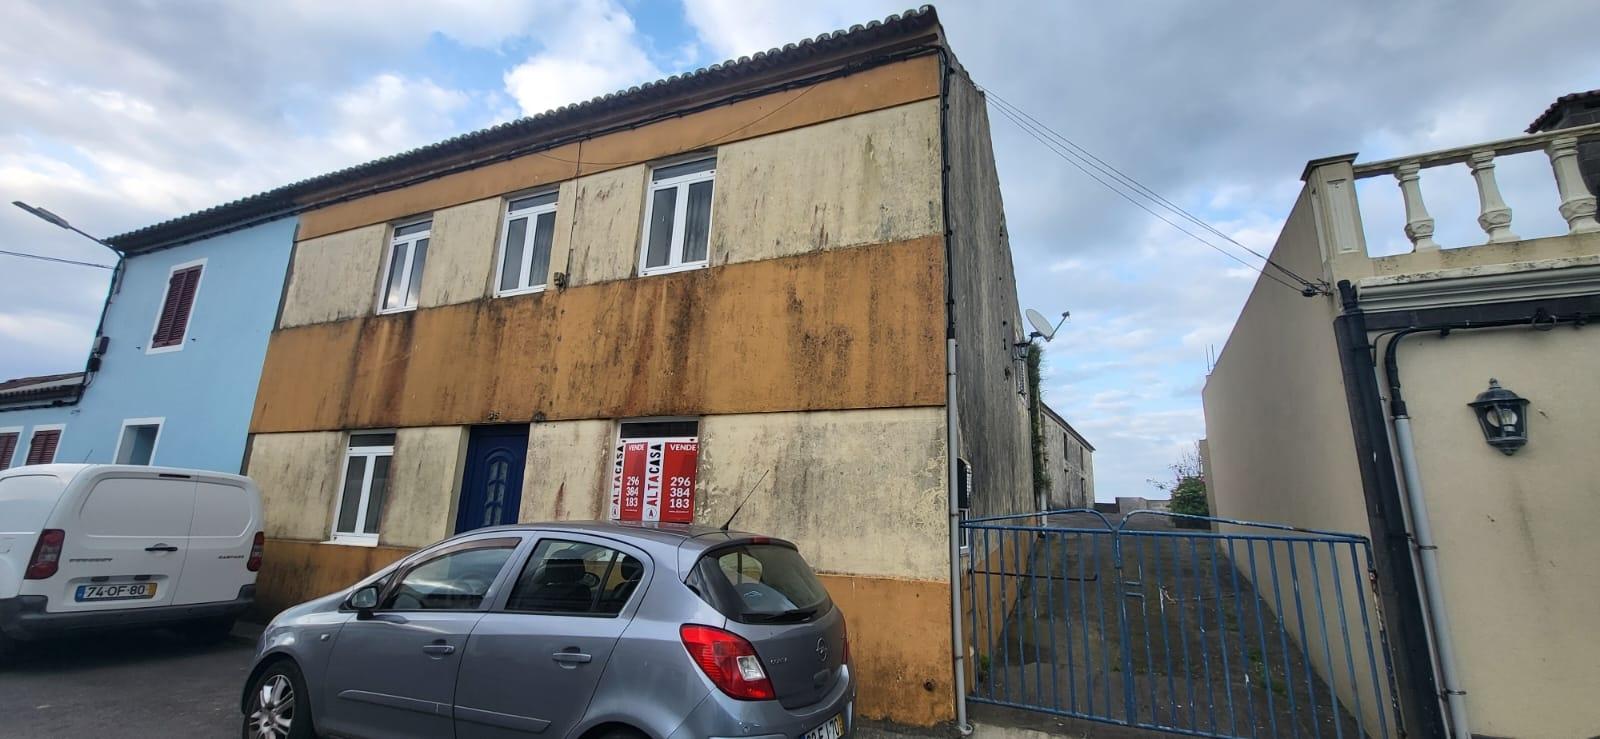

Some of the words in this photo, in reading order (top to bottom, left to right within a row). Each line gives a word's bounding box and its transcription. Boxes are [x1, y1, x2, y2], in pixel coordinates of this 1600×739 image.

[628, 443, 645, 451] VENDE
[670, 443, 697, 451] VENDE
[612, 446, 624, 505] ALTACASA
[646, 444, 662, 507] ALTACASA
[626, 476, 640, 486] 296
[670, 476, 691, 487] 296
[626, 486, 639, 497] 384
[669, 487, 690, 497] 384
[625, 497, 638, 507] 183
[669, 498, 690, 508] 183
